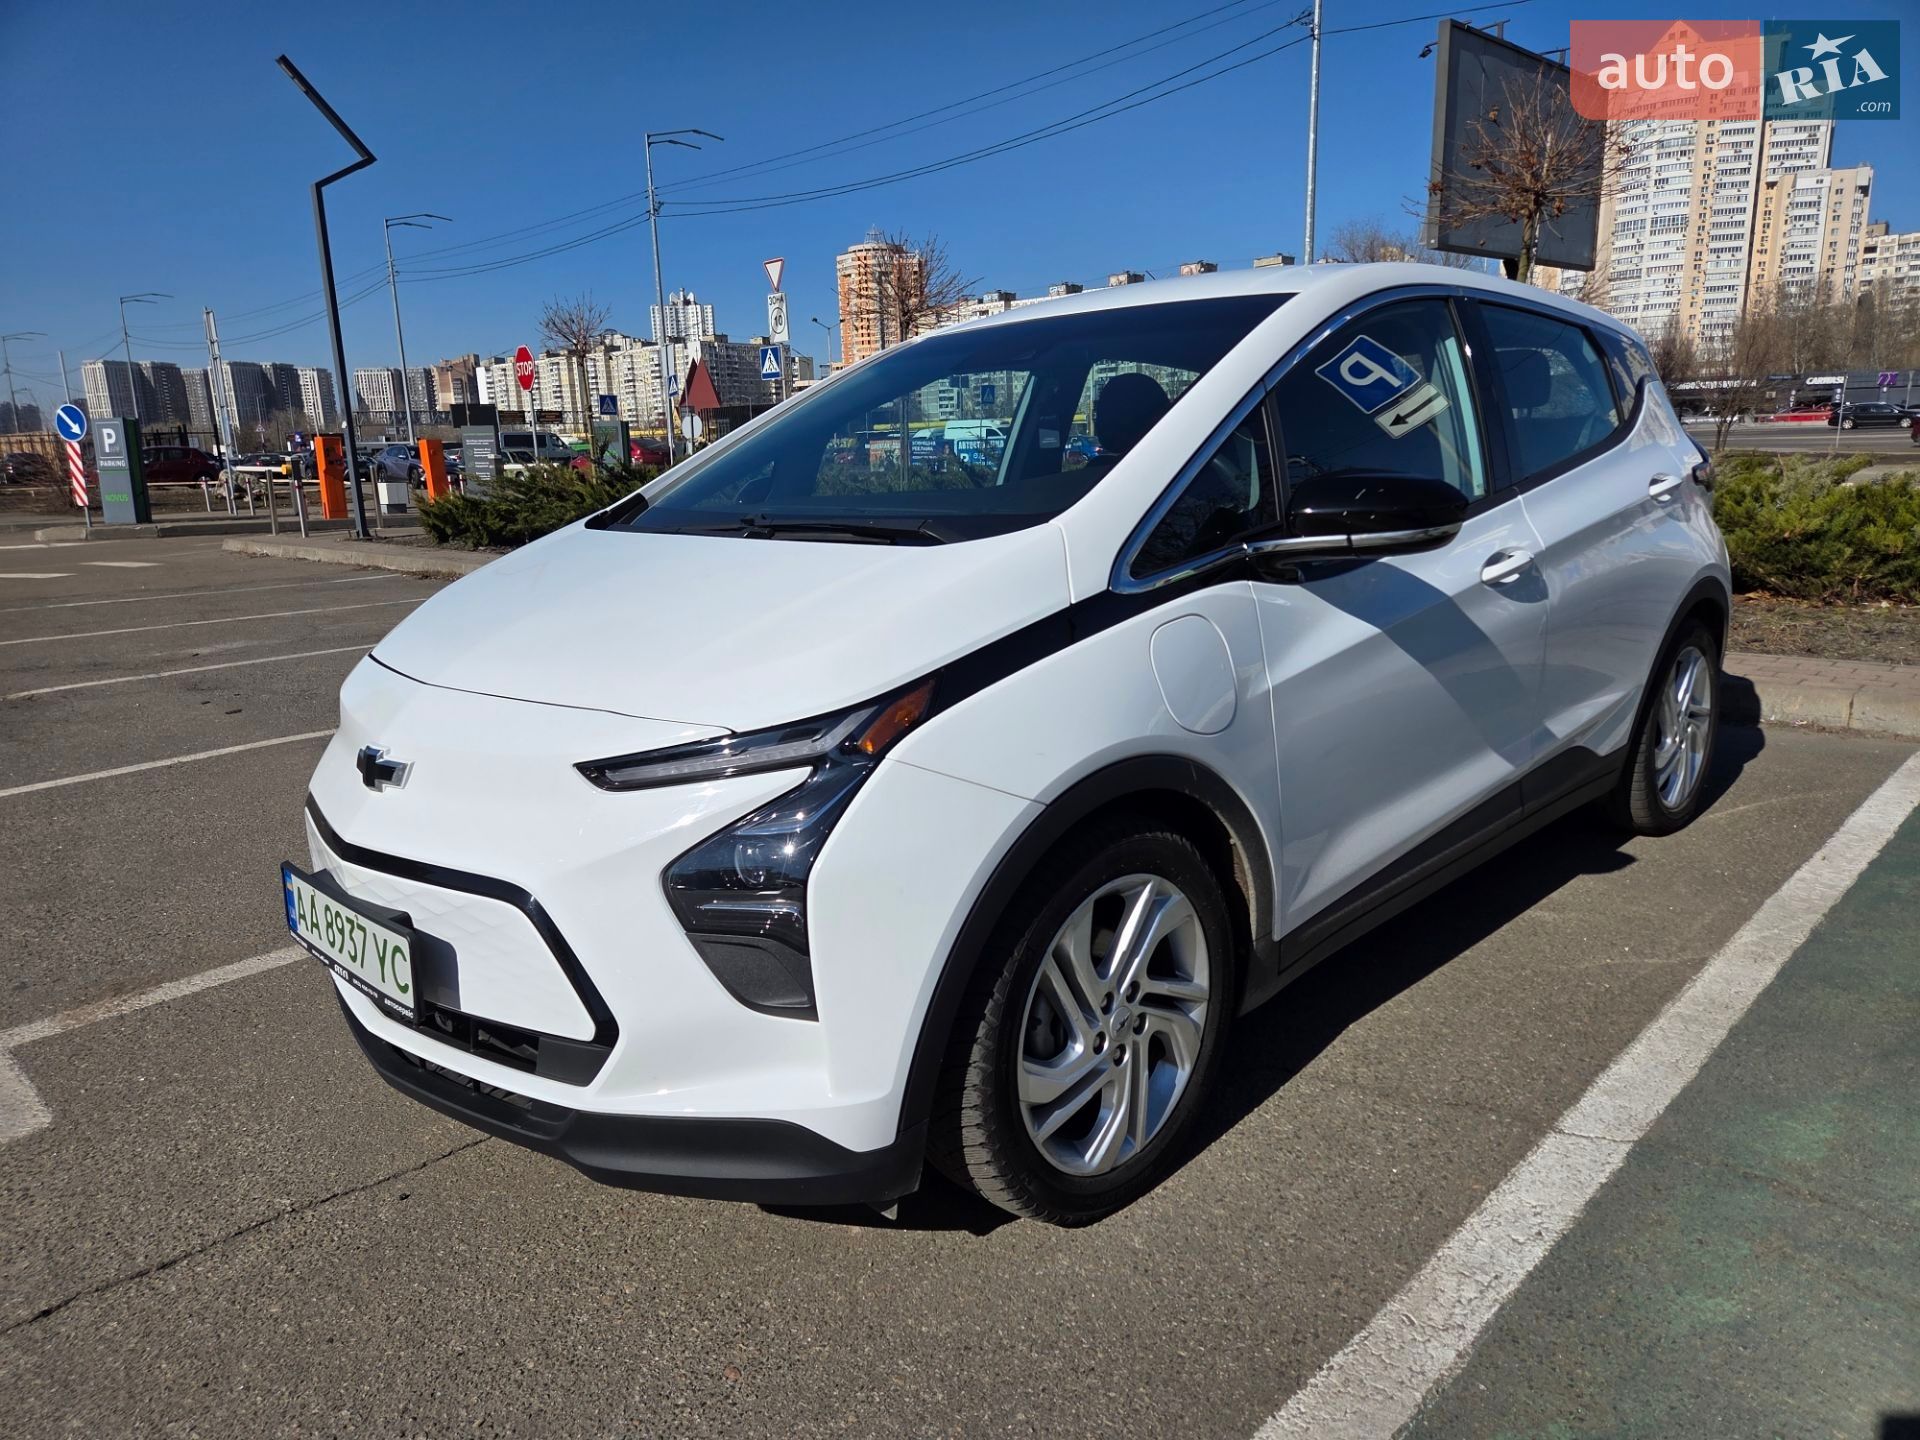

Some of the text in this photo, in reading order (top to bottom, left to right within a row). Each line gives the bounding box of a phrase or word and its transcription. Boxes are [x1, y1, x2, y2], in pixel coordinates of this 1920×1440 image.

[774, 314, 783, 327] 10
[516, 361, 533, 376] STOP
[102, 428, 116, 453] P
[100, 459, 126, 468] PARKING
[297, 886, 409, 994] AA 8937 YC
